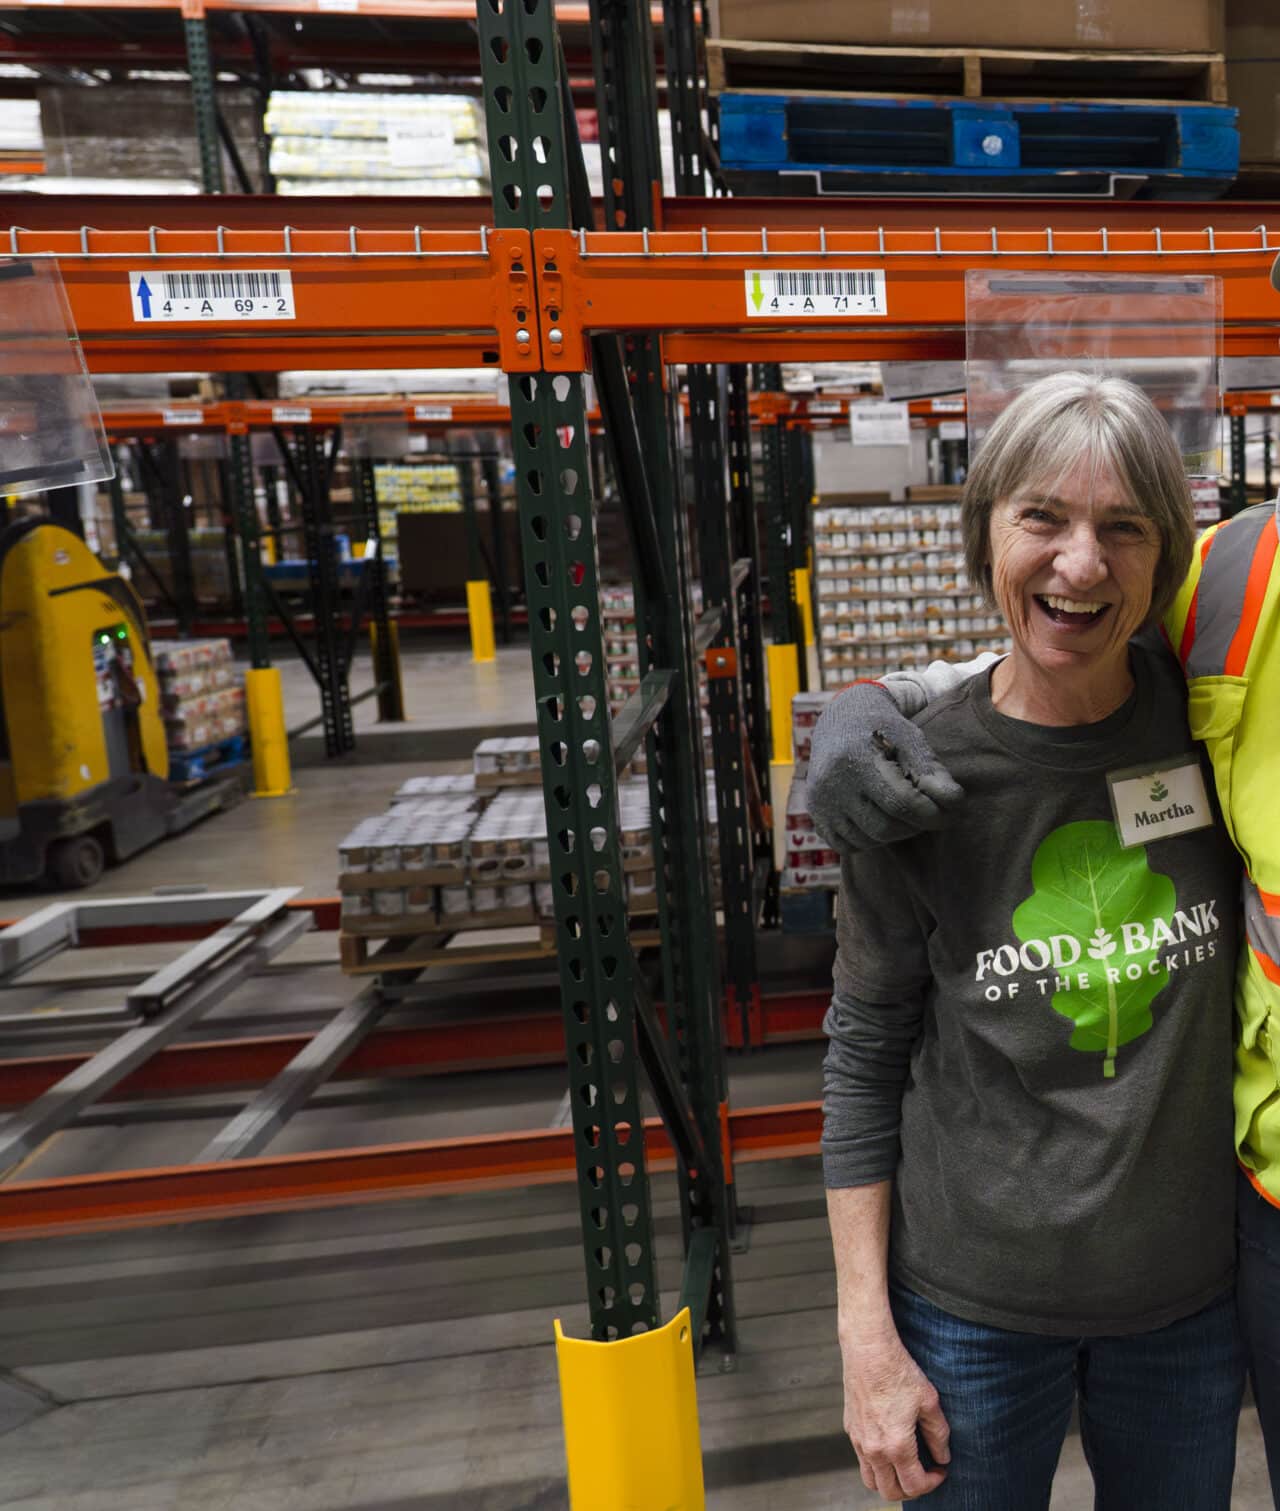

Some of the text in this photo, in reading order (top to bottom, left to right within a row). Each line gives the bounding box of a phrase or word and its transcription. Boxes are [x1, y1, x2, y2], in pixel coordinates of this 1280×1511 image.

[163, 300, 172, 313] 4
[201, 300, 213, 313] A
[234, 299, 254, 312] 69
[277, 299, 286, 312] 2
[770, 297, 779, 309] 4
[803, 297, 815, 309] A
[832, 297, 849, 309] 71
[870, 297, 877, 308] 1
[1134, 803, 1195, 828] Martha
[975, 900, 1220, 982] FOOD BANK
[984, 944, 1216, 1002] OF THE ROCKIES
